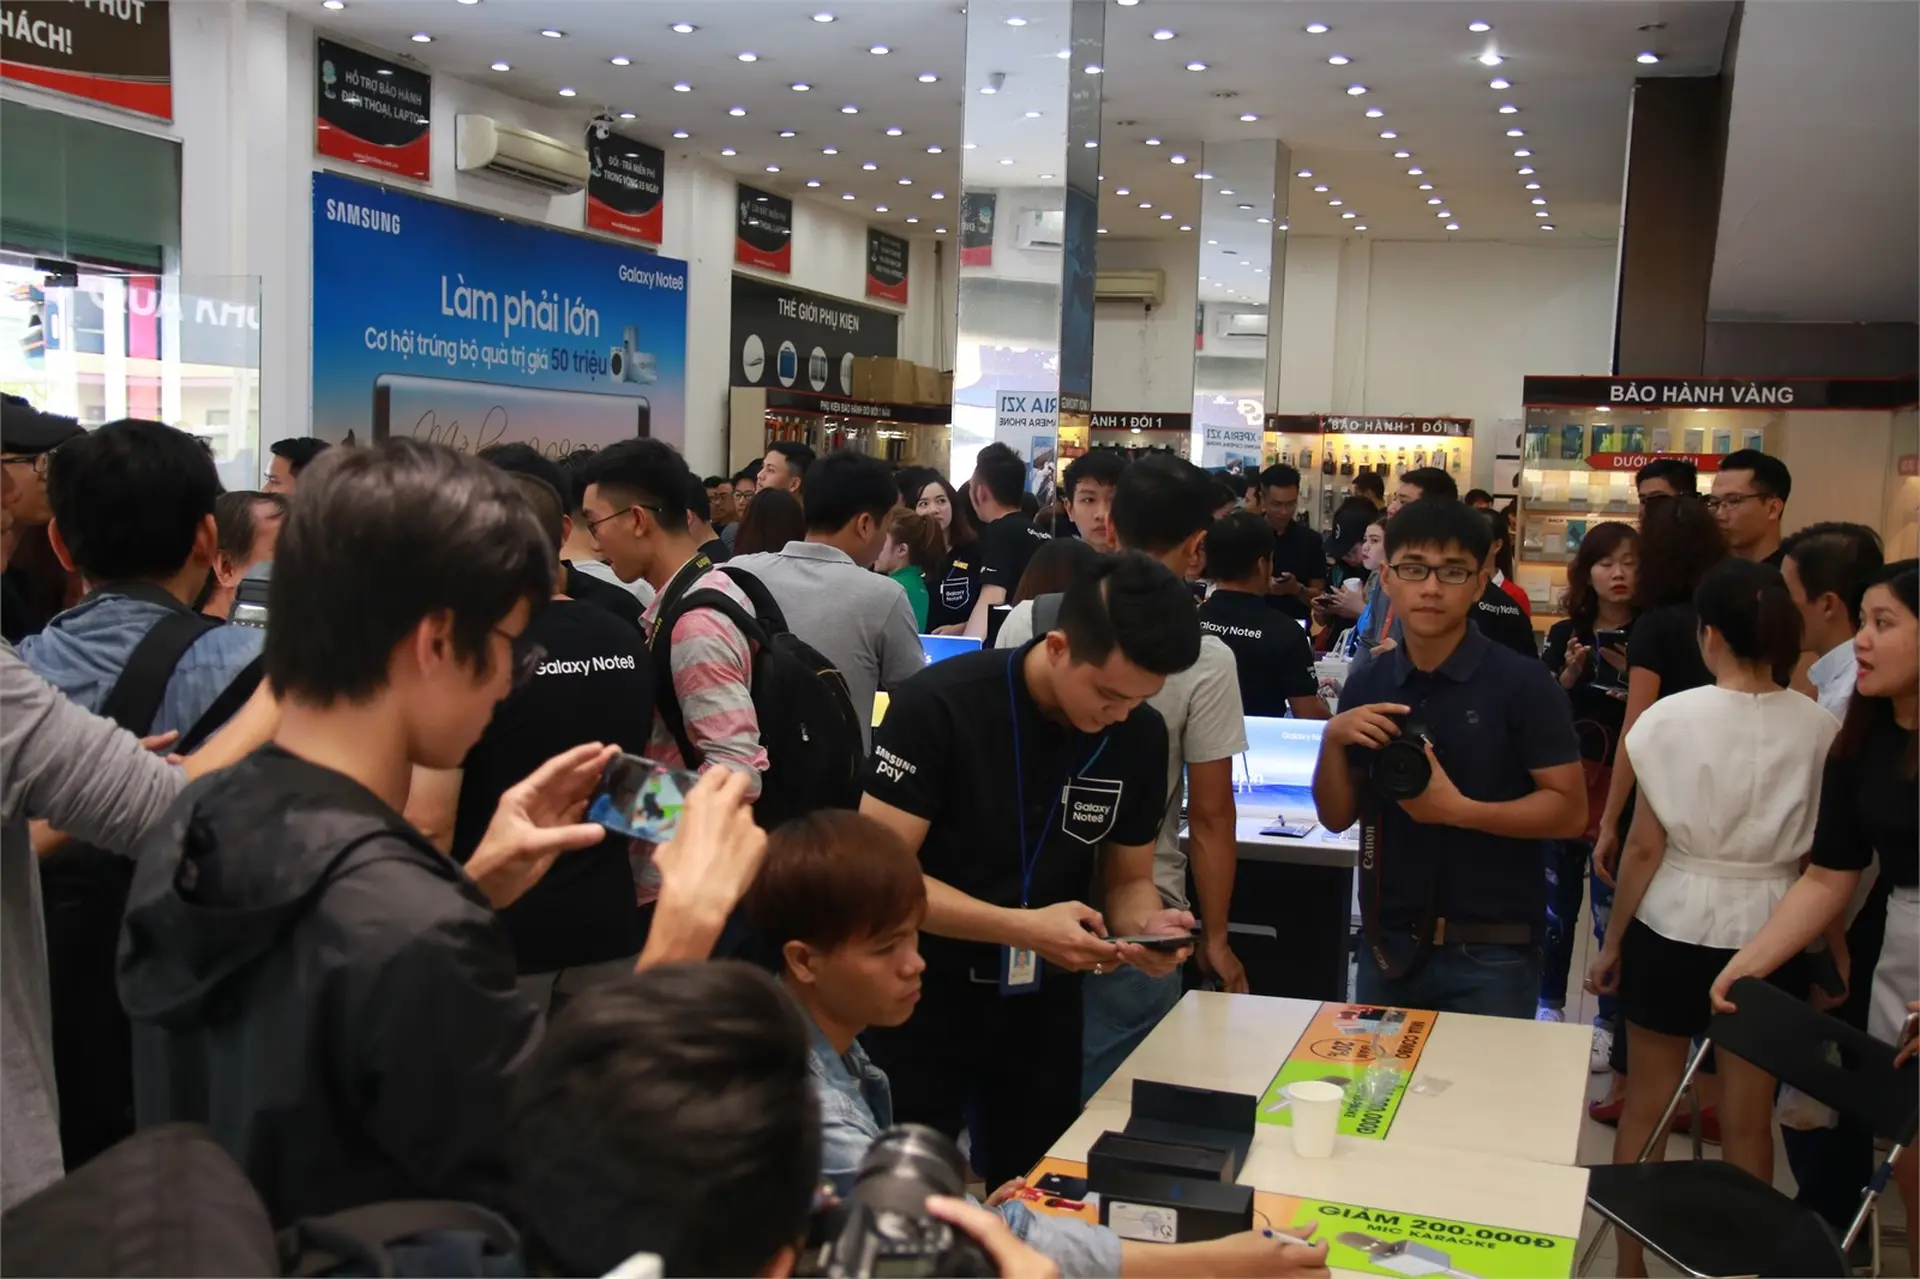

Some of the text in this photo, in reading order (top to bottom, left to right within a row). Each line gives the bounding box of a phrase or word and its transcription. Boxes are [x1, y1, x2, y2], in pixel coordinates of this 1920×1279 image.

[326, 198, 401, 236] SAMSUNG
[618, 264, 684, 291] Galaxy Note8
[441, 273, 600, 339] Làm phải lớn
[778, 297, 860, 334] THẾ GIỚI PHỤ KIỆN
[365, 327, 608, 381] Cơ hội trúng bộ quà trị giá 50 triệu
[1610, 382, 1794, 404] BẢO HÀNH VÀNG
[1120, 417, 1126, 427] 1
[1156, 418, 1162, 428] 1
[1331, 416, 1359, 430] BẢO
[1422, 420, 1447, 432] ĐỔI
[1613, 455, 1648, 468] DƯỚI
[1200, 621, 1262, 639] alaxy Note8
[592, 655, 635, 672] Note8
[875, 745, 917, 774] SAMSUNG
[876, 760, 904, 783] pay
[1072, 811, 1104, 823] Note8
[1073, 801, 1111, 815] Galaxy
[1362, 826, 1376, 869] Canon
[1318, 1206, 1556, 1249] GIẢM 200.000Đ
[1367, 1223, 1498, 1250] MIC KARAOKE
